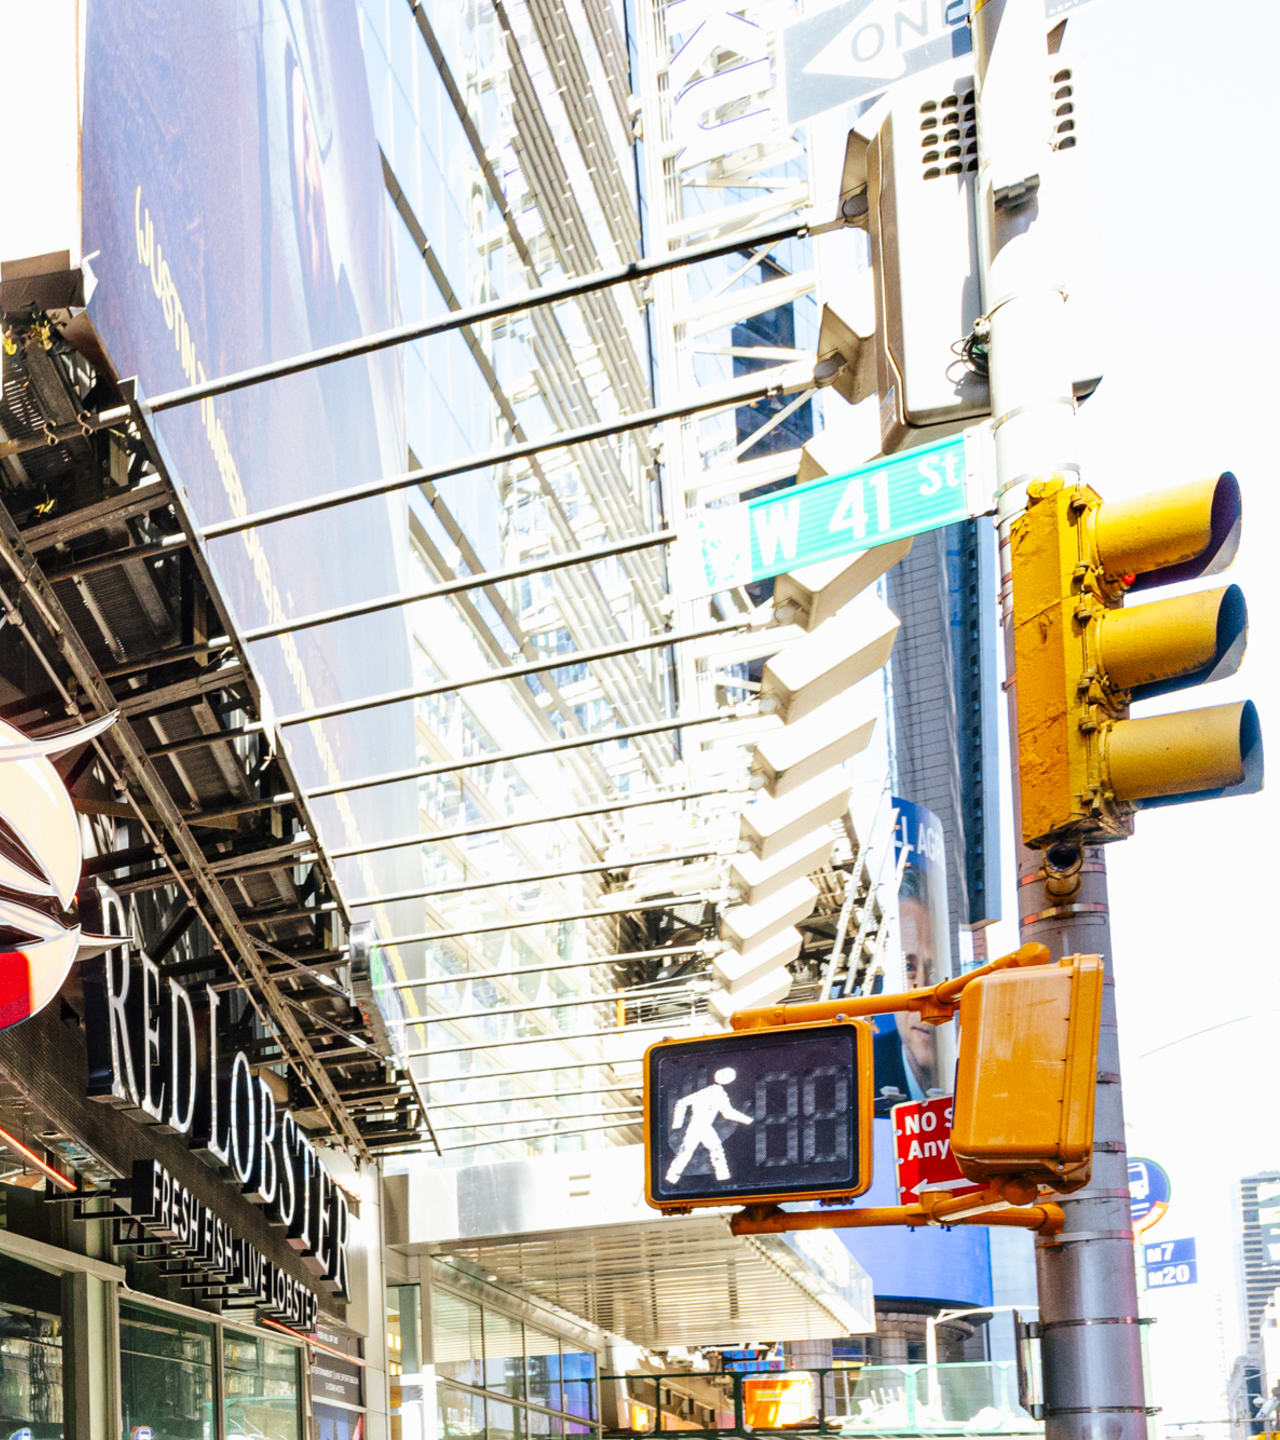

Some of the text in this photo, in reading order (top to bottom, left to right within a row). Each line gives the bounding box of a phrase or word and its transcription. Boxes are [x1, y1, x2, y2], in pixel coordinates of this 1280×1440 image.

[752, 450, 959, 566] W 41 St
[96, 874, 352, 1304] RED LOBSTER
[904, 1111, 938, 1136] NO
[151, 1158, 319, 1335] FRESH FISH LIVE LOBSTER
[1146, 1242, 1175, 1263] M7
[1148, 1264, 1190, 1287] M20
